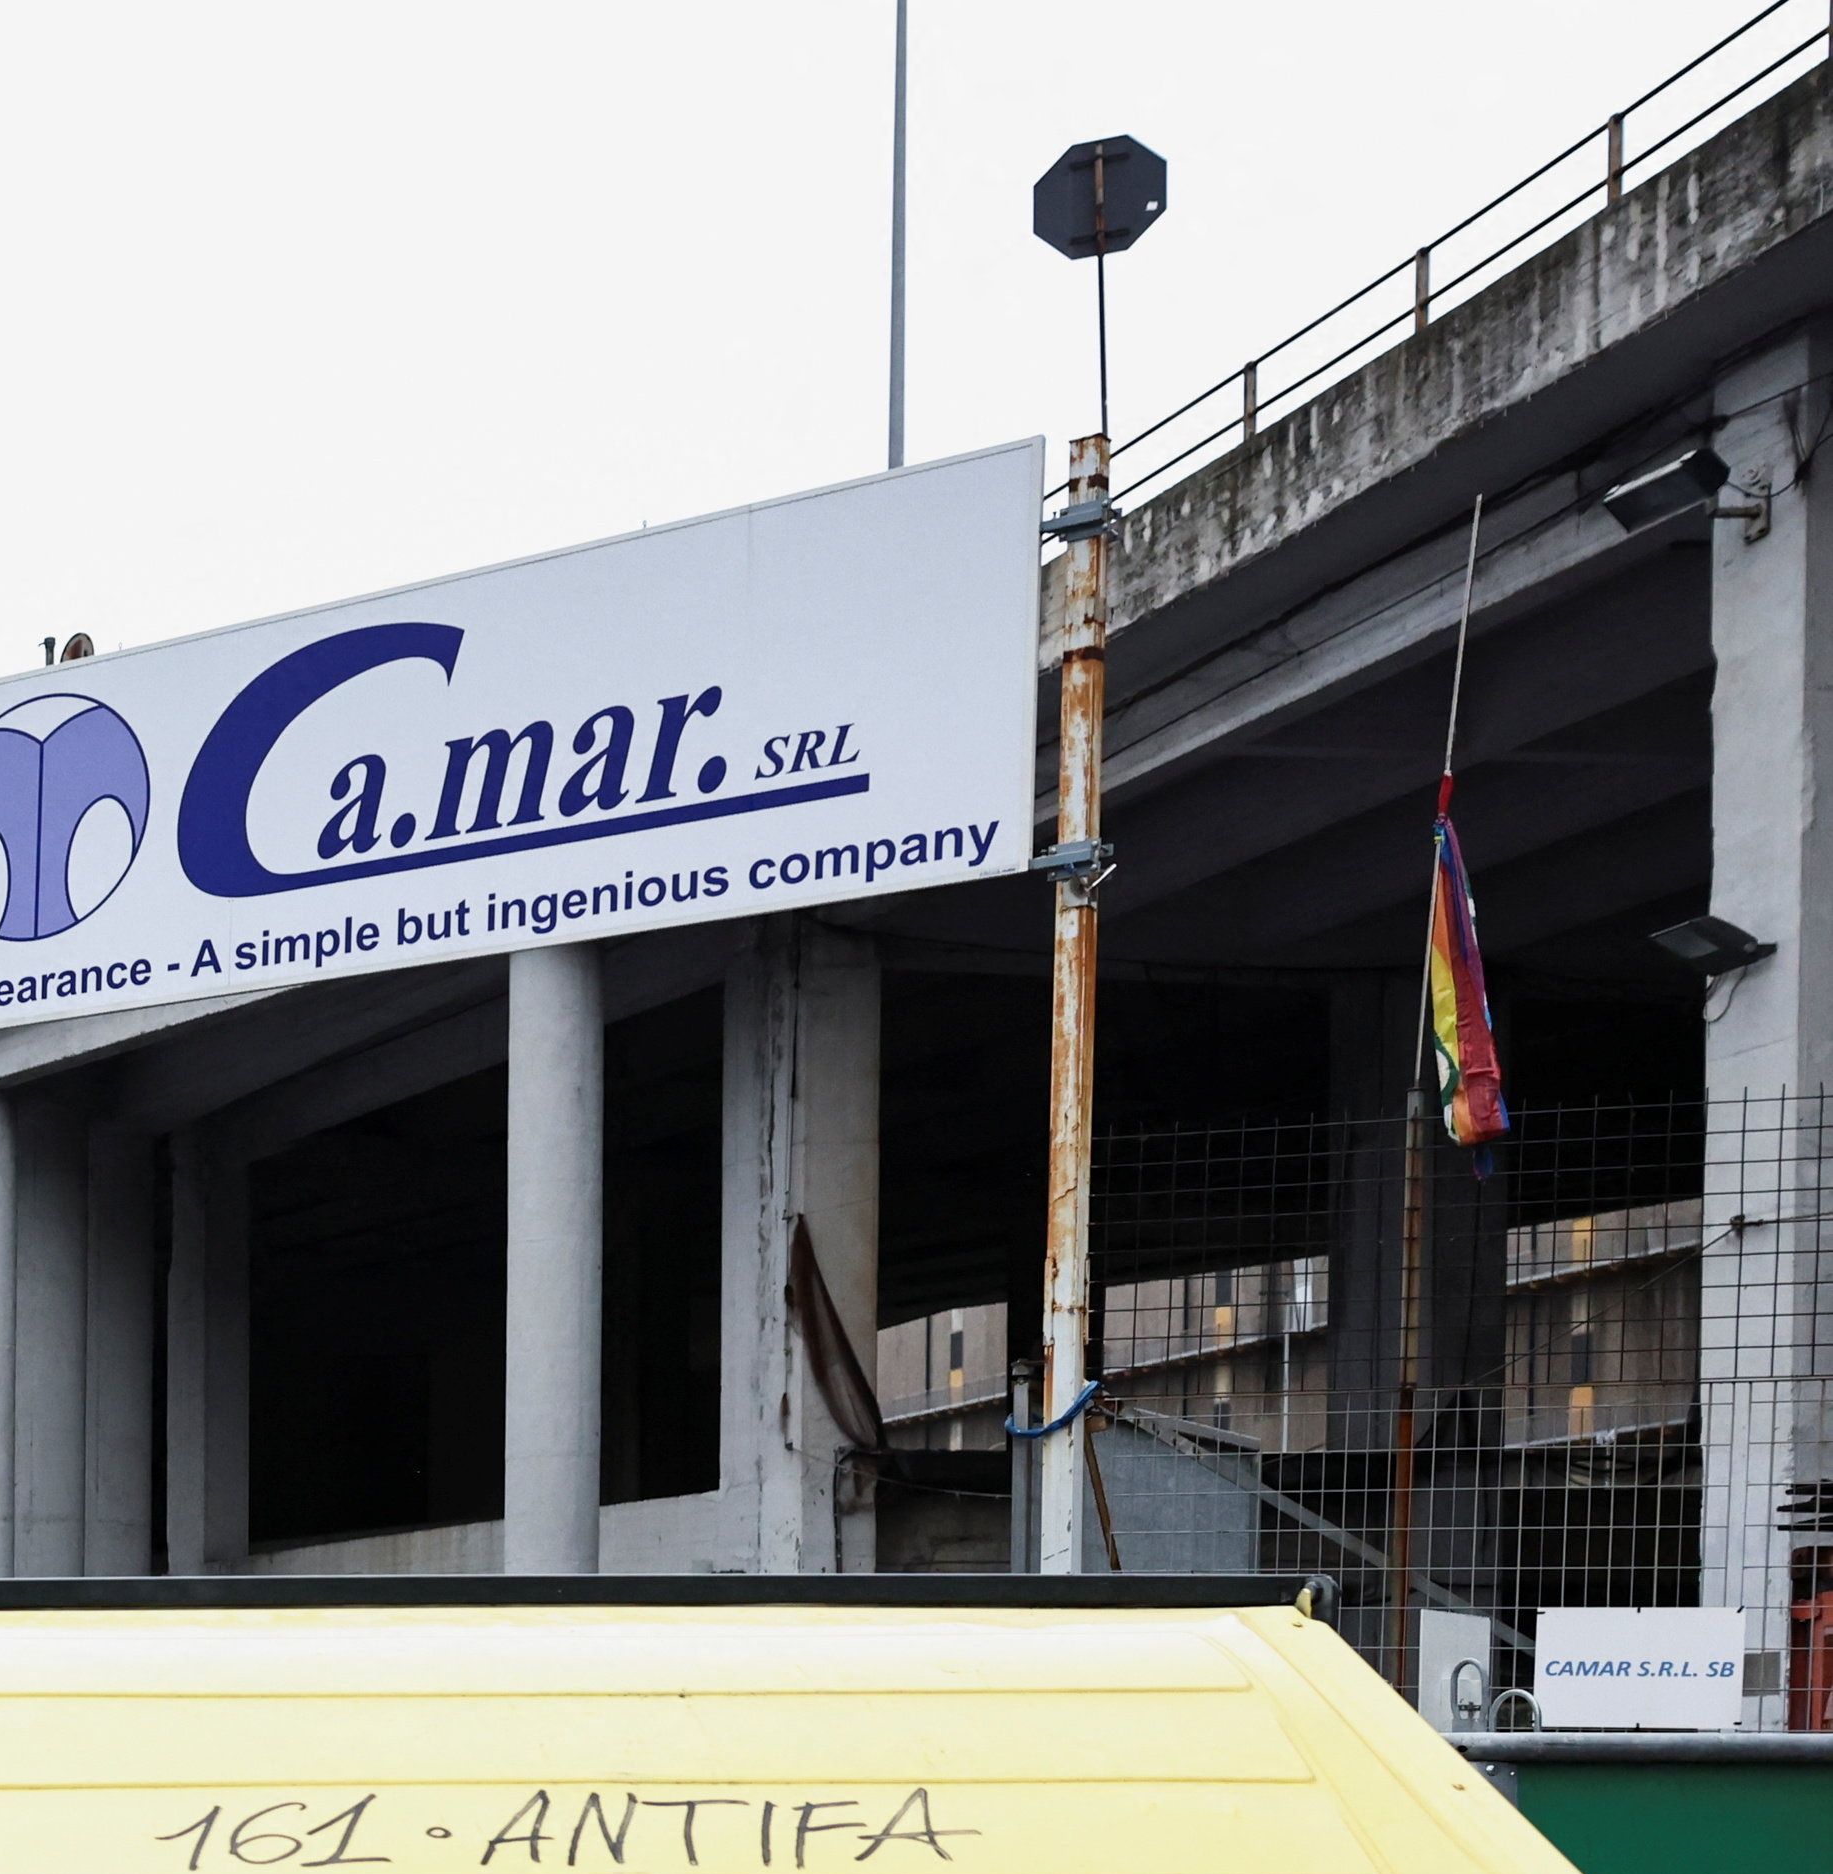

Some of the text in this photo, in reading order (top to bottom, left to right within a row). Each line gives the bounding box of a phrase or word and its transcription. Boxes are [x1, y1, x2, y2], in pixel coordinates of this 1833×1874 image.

[754, 720, 864, 783] SRL
[190, 936, 223, 978] A
[234, 915, 381, 974] simple
[395, 897, 470, 945] but
[485, 863, 731, 932] ingenious
[747, 820, 1000, 889] company
[1545, 1661, 1735, 1677] CAMAR S.R.L. SB
[156, 1788, 982, 1870] 161 ANTIFA
